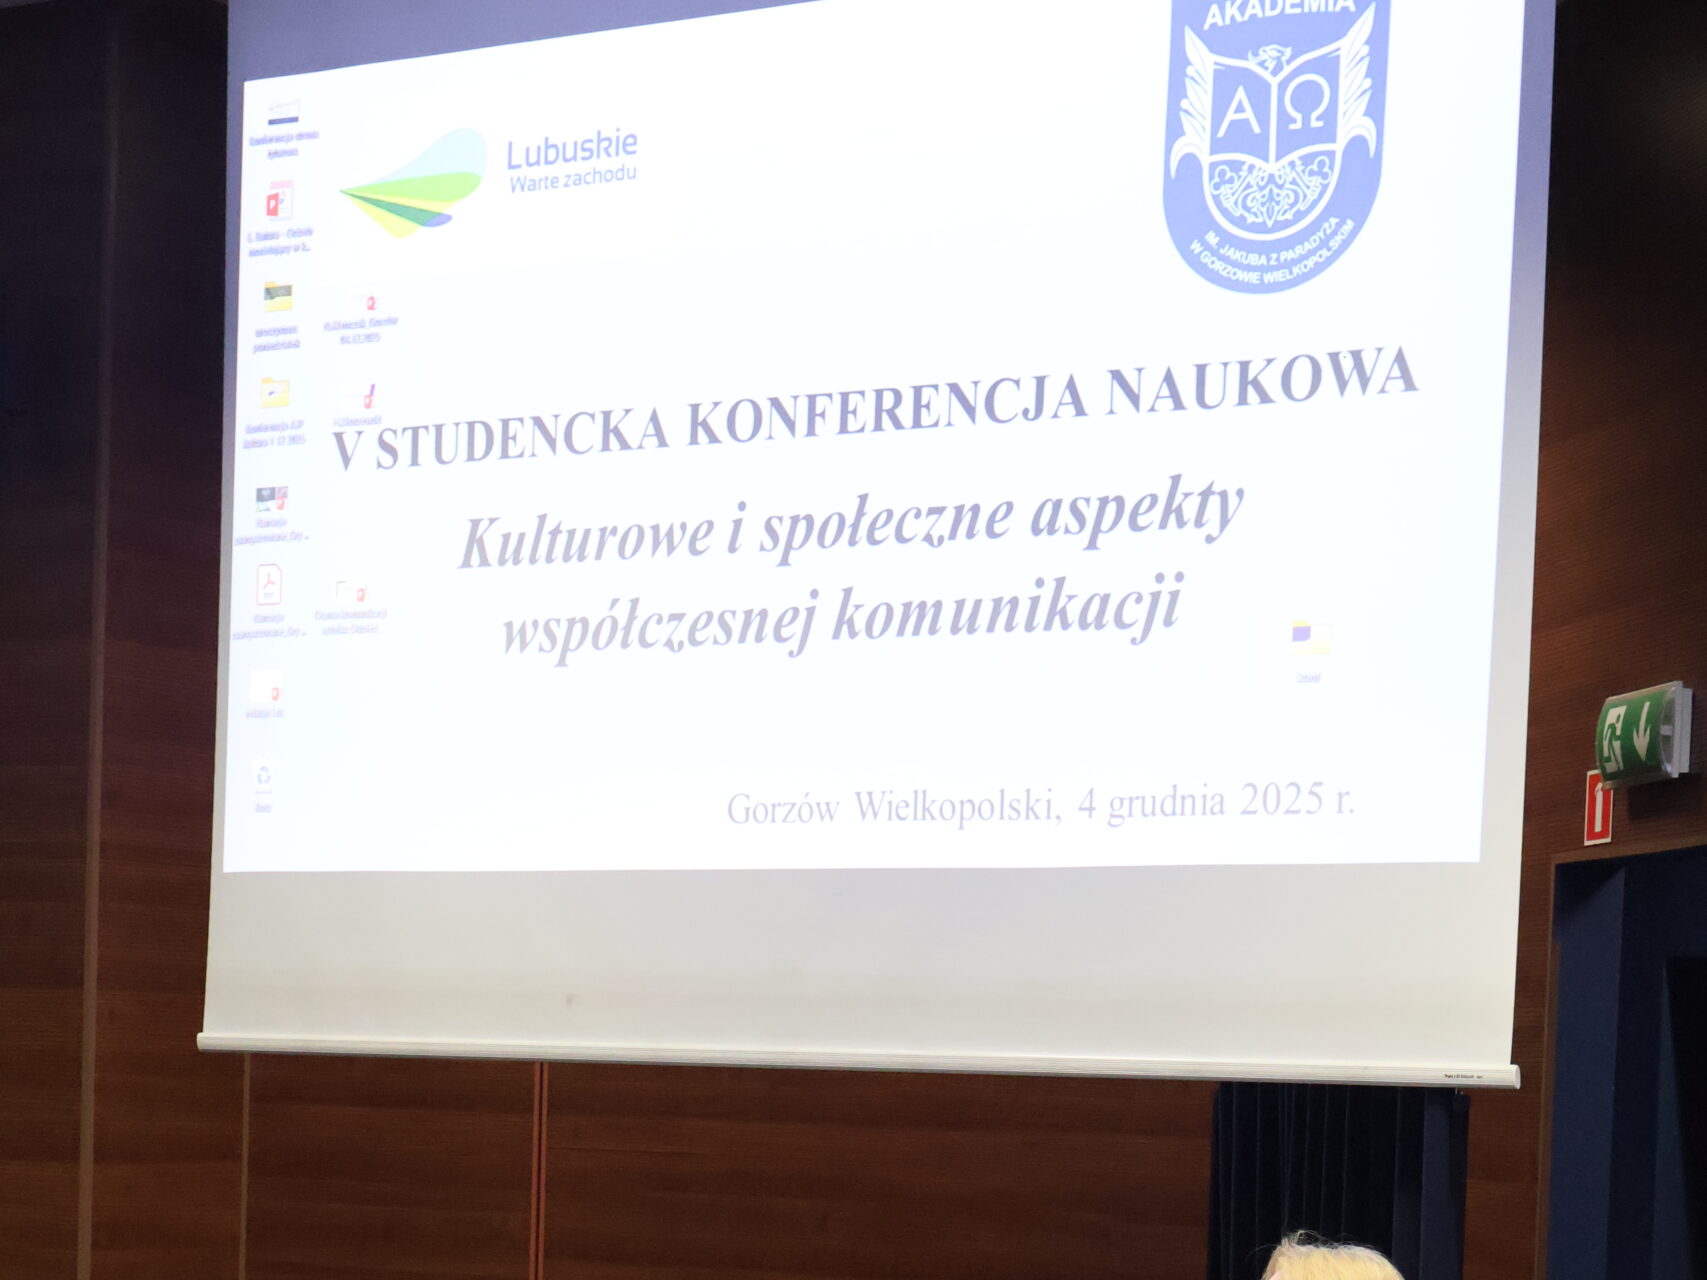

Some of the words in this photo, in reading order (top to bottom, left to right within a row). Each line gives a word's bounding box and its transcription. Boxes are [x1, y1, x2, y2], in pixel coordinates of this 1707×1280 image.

[1216, 85, 1261, 138] A
[1284, 73, 1330, 130] Ω
[507, 127, 637, 170] Lubuskie
[510, 175, 559, 194] Warte
[563, 163, 637, 188] zachodu
[1190, 239, 1203, 254] W
[1200, 251, 1261, 284] GORZOWIE
[1263, 218, 1355, 284] WIELKOPOLSKIM
[1219, 244, 1267, 266] JAKUBA
[1270, 253, 1278, 265] Z
[332, 430, 364, 472] V
[376, 407, 669, 470] STUDENCKA
[687, 373, 1088, 446] KONFERENCJA
[1105, 346, 1419, 415] NAUKOWA
[457, 513, 714, 569] Kulturowe
[727, 501, 747, 554] i
[759, 493, 1014, 567] społeczne
[1030, 473, 1244, 551] aspekty
[503, 588, 819, 667] współczesnej
[832, 571, 1184, 646] komunikacji
[728, 792, 840, 824] Gorzów
[854, 788, 1061, 831] Wielkopolski,
[1078, 787, 1096, 819] 4
[1107, 783, 1226, 828] grudnia
[1240, 781, 1323, 815] 2025
[1336, 791, 1354, 814] r.
